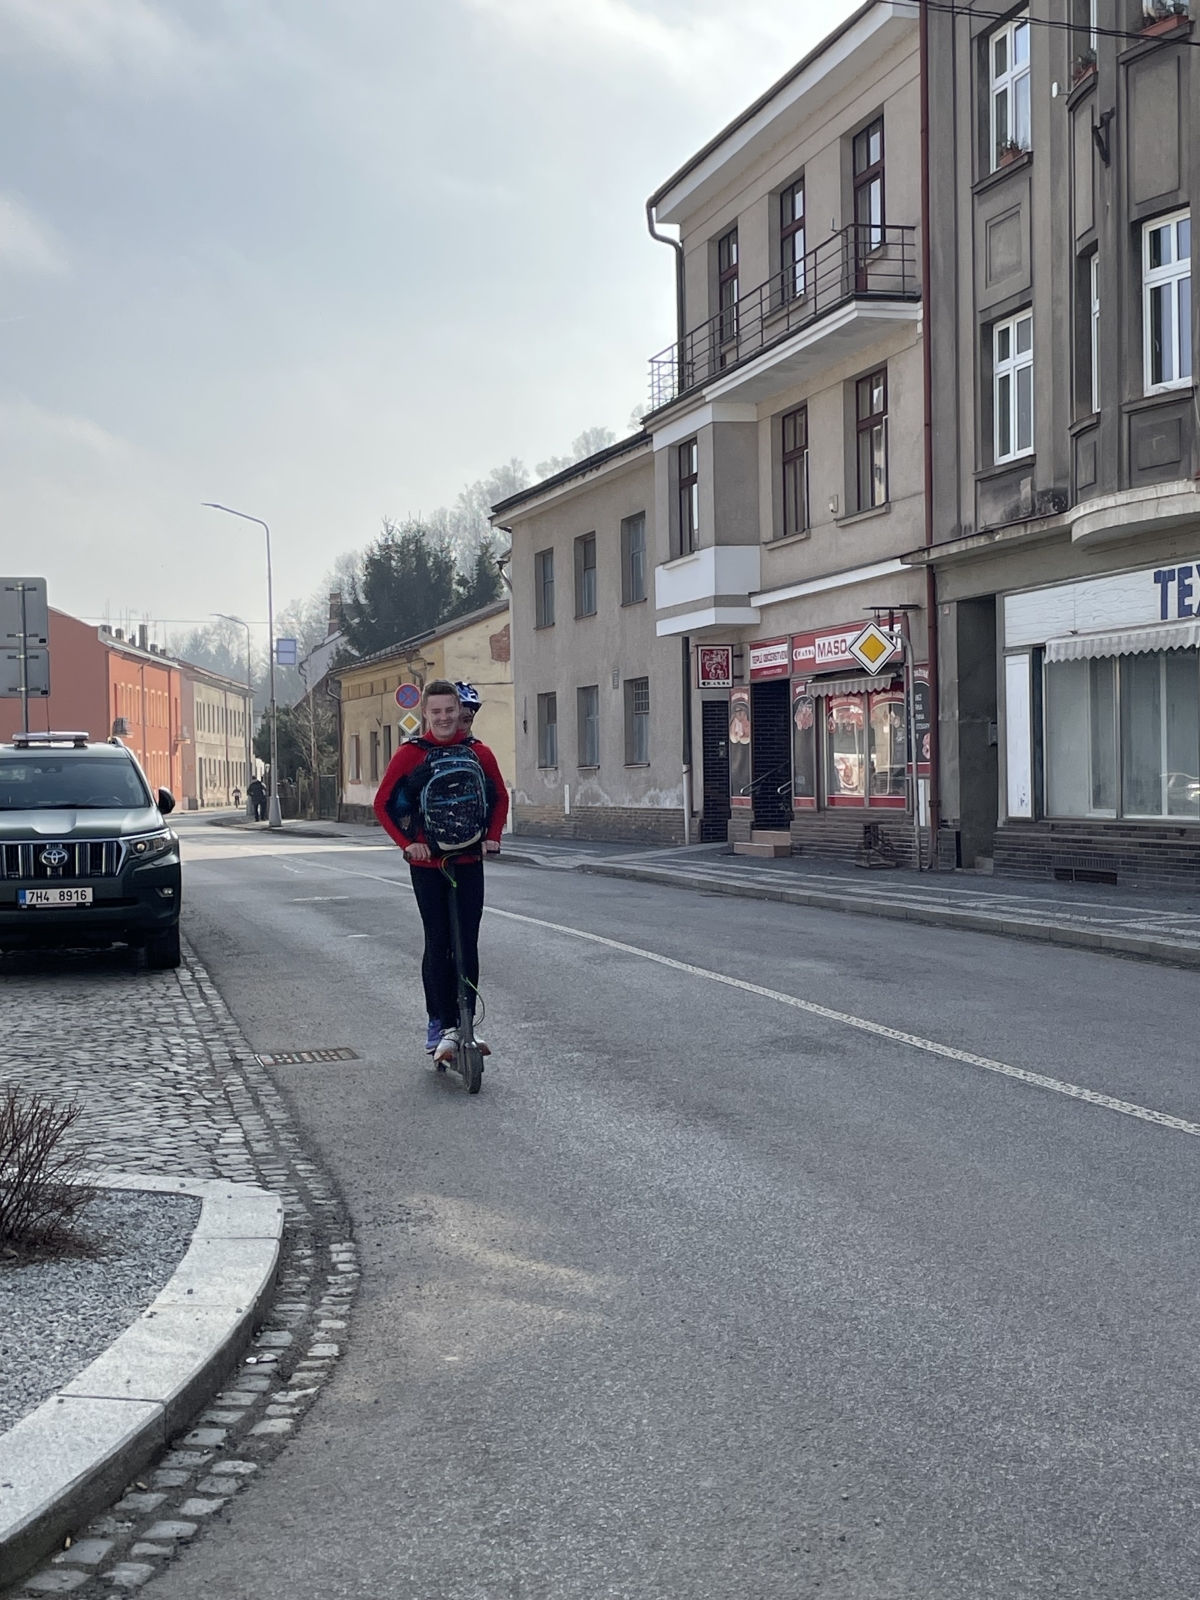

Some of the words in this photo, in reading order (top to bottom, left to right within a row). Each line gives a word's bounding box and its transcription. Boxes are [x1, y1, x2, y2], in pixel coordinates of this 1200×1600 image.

[1154, 565, 1200, 620] TE
[817, 638, 847, 659] MASO
[28, 891, 50, 903] 7H4
[58, 889, 87, 901] 8916
